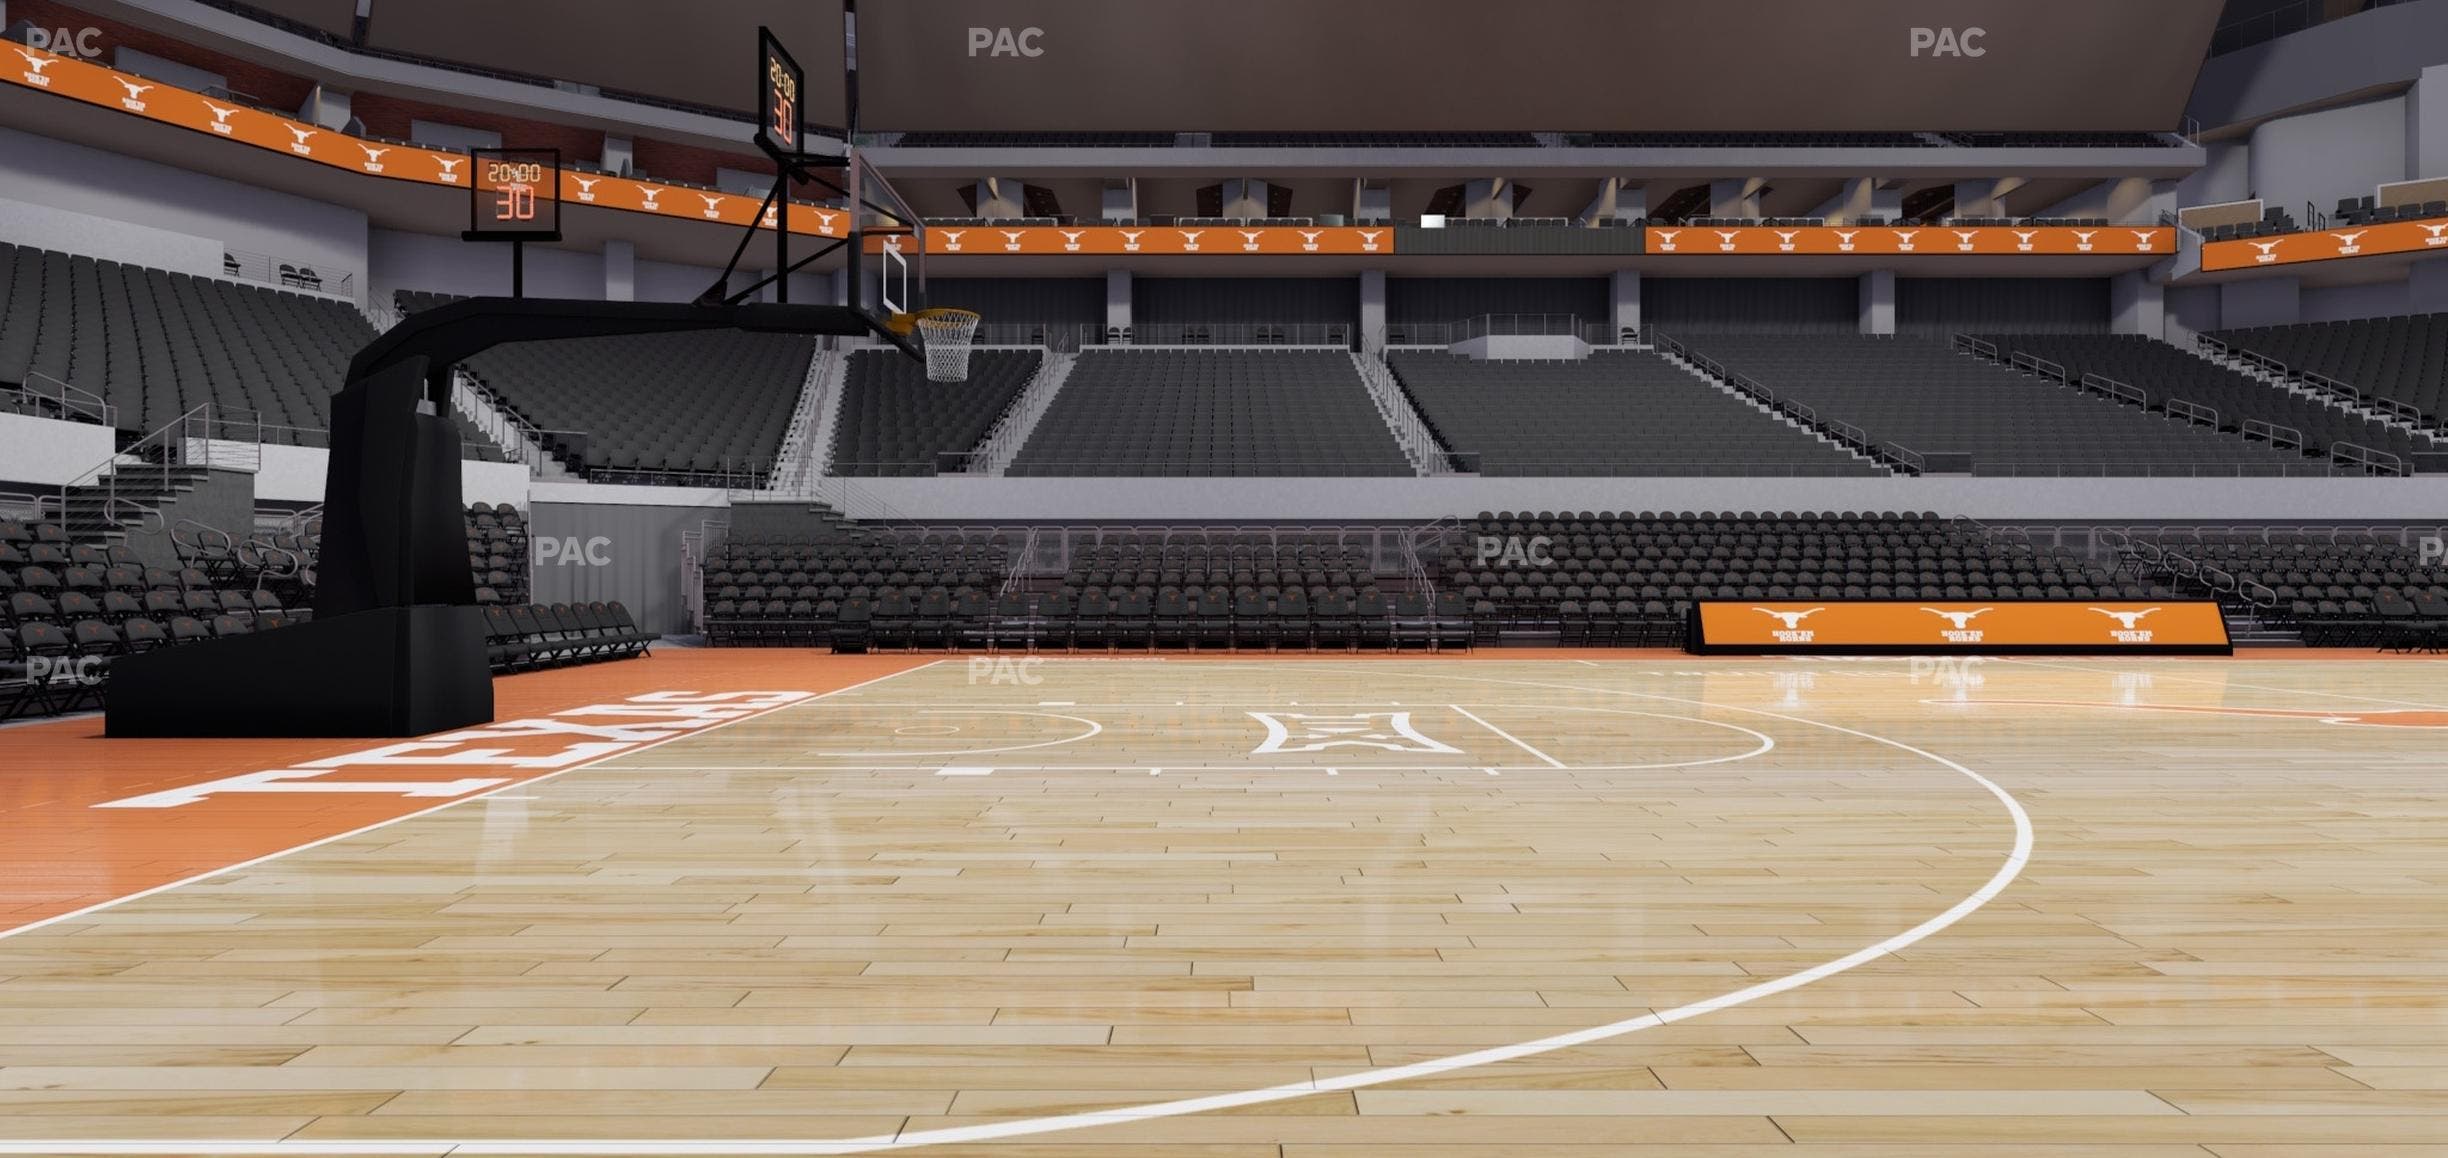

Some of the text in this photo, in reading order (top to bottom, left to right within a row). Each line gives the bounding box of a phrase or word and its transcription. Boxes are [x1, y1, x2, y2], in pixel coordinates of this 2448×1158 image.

[770, 56, 796, 103] 20:00
[774, 88, 792, 145] 30
[496, 183, 534, 220] 30
[91, 691, 815, 808] TEXAS
